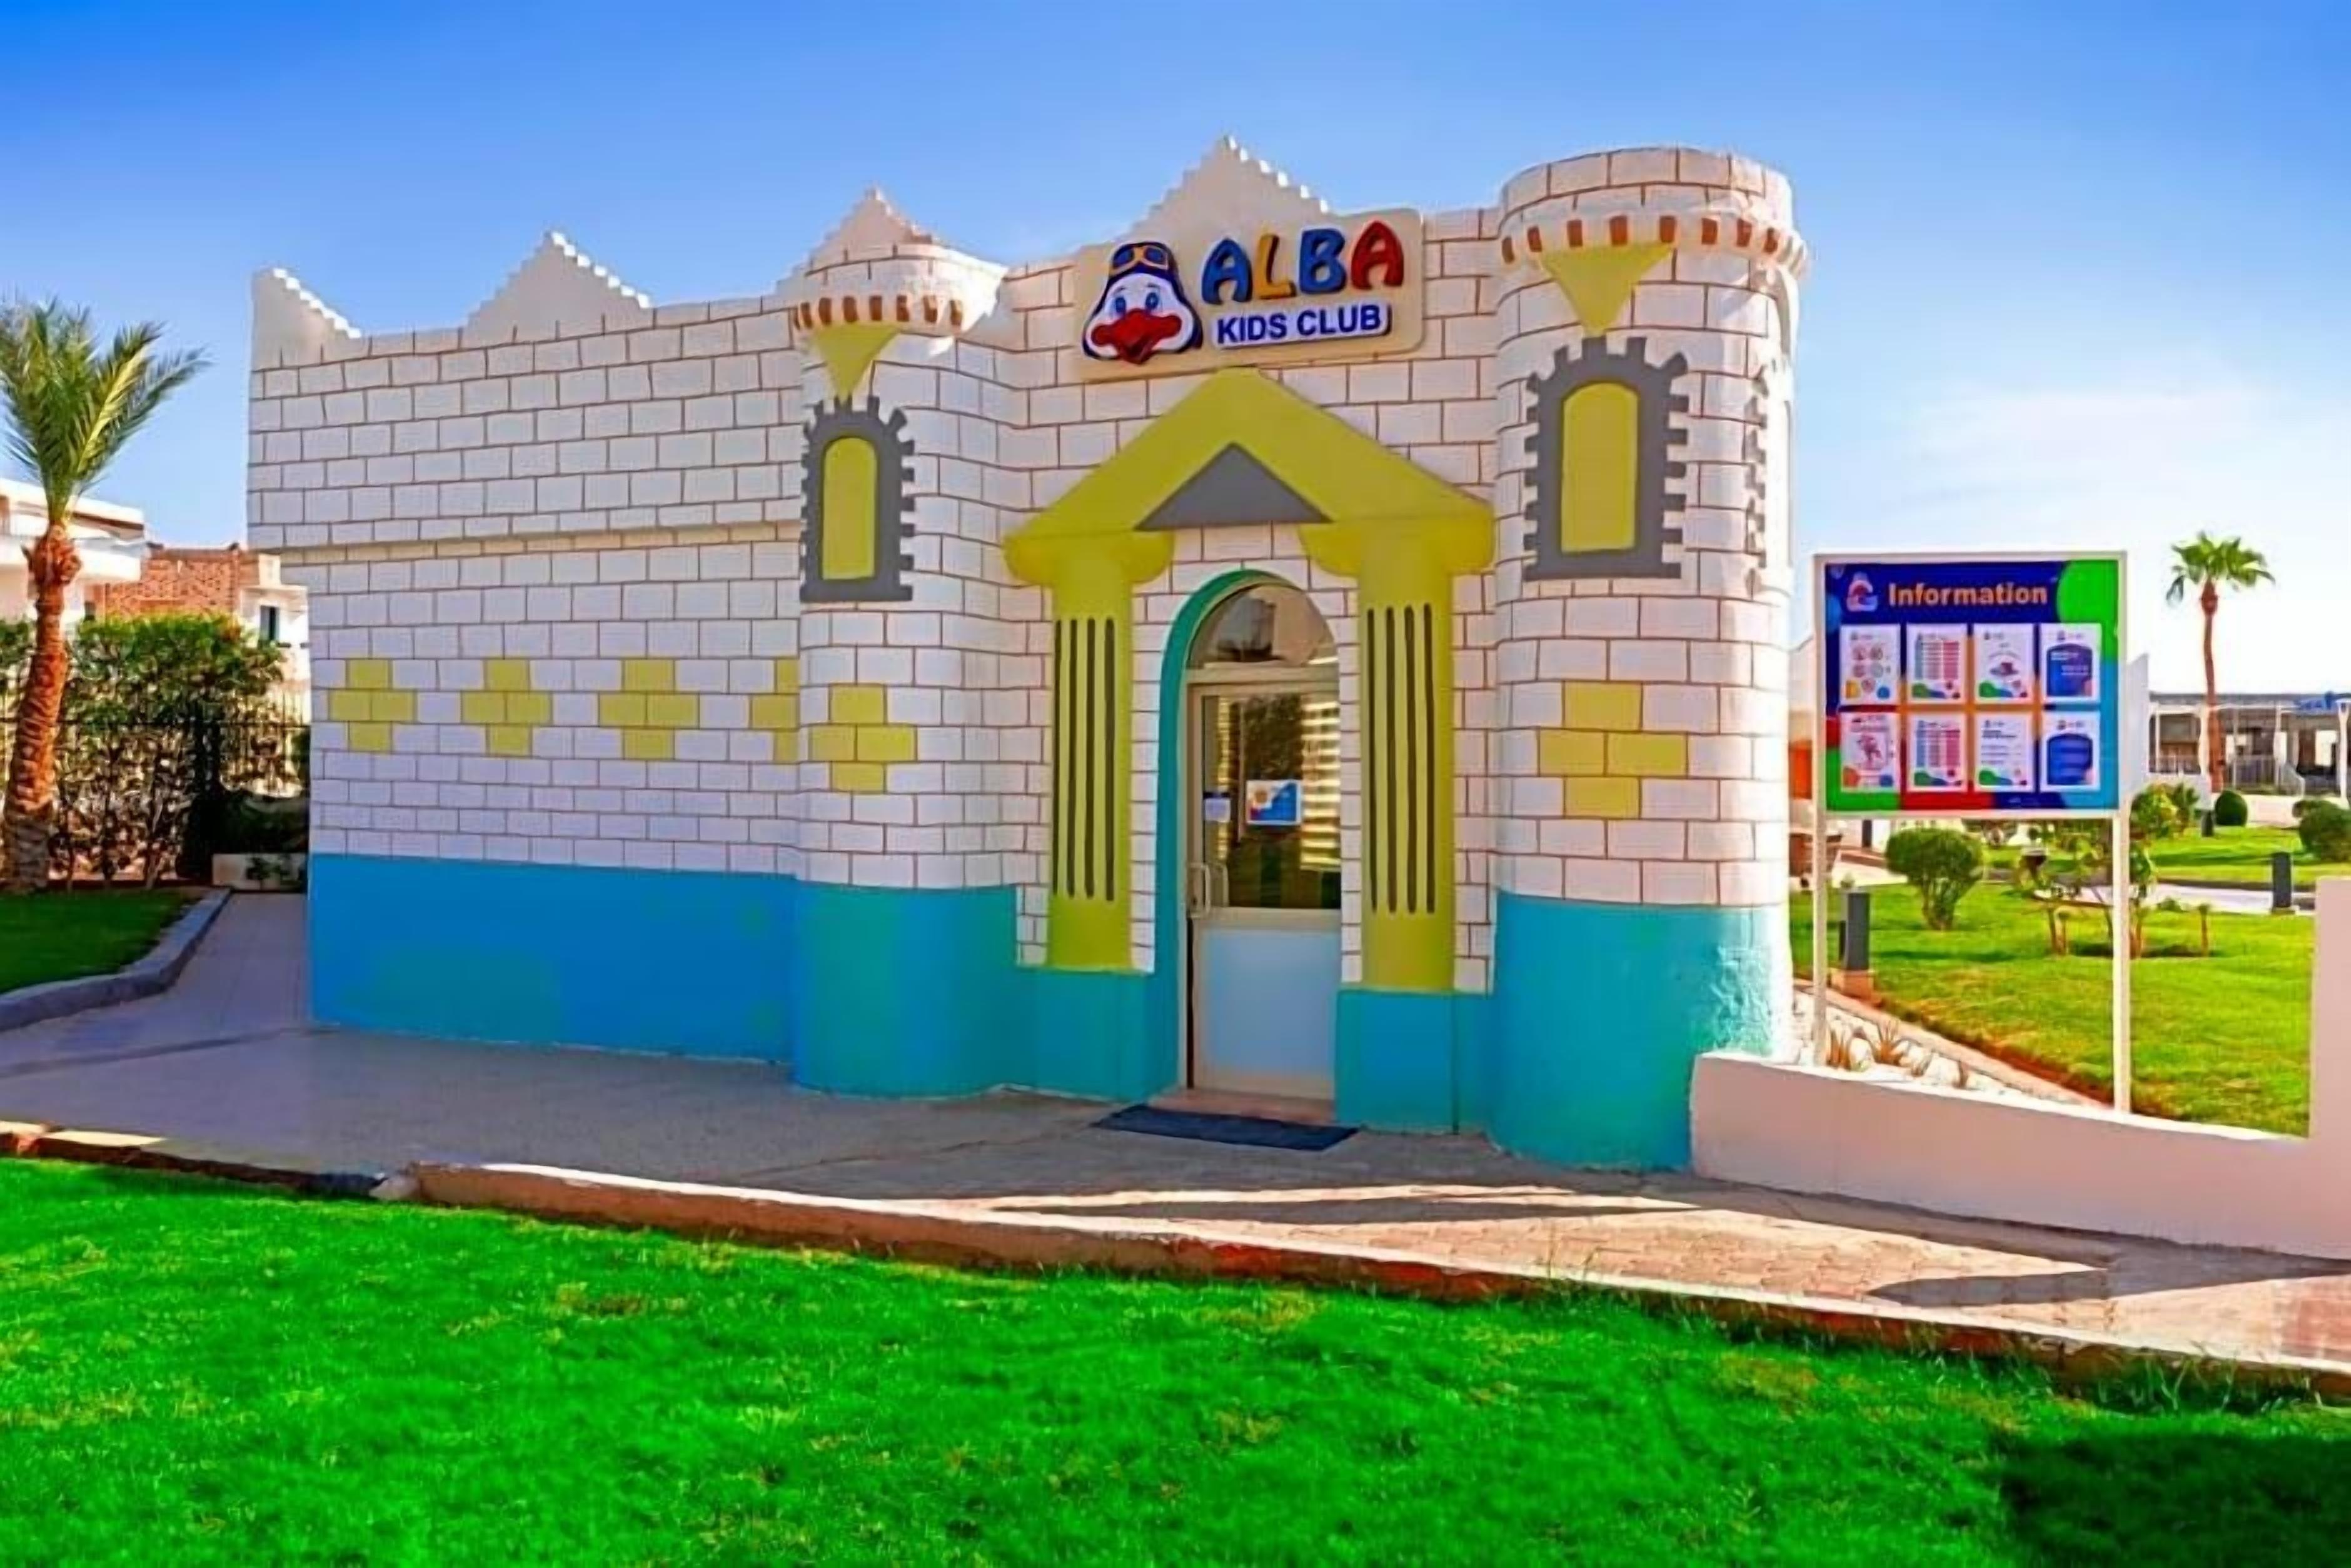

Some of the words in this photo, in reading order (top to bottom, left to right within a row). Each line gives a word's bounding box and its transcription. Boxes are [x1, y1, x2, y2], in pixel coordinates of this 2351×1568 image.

[1201, 221, 1404, 304] ALBA
[1217, 313, 1287, 344] KIDS
[1296, 304, 1381, 336] CLUB
[1889, 582, 2048, 606] Information
